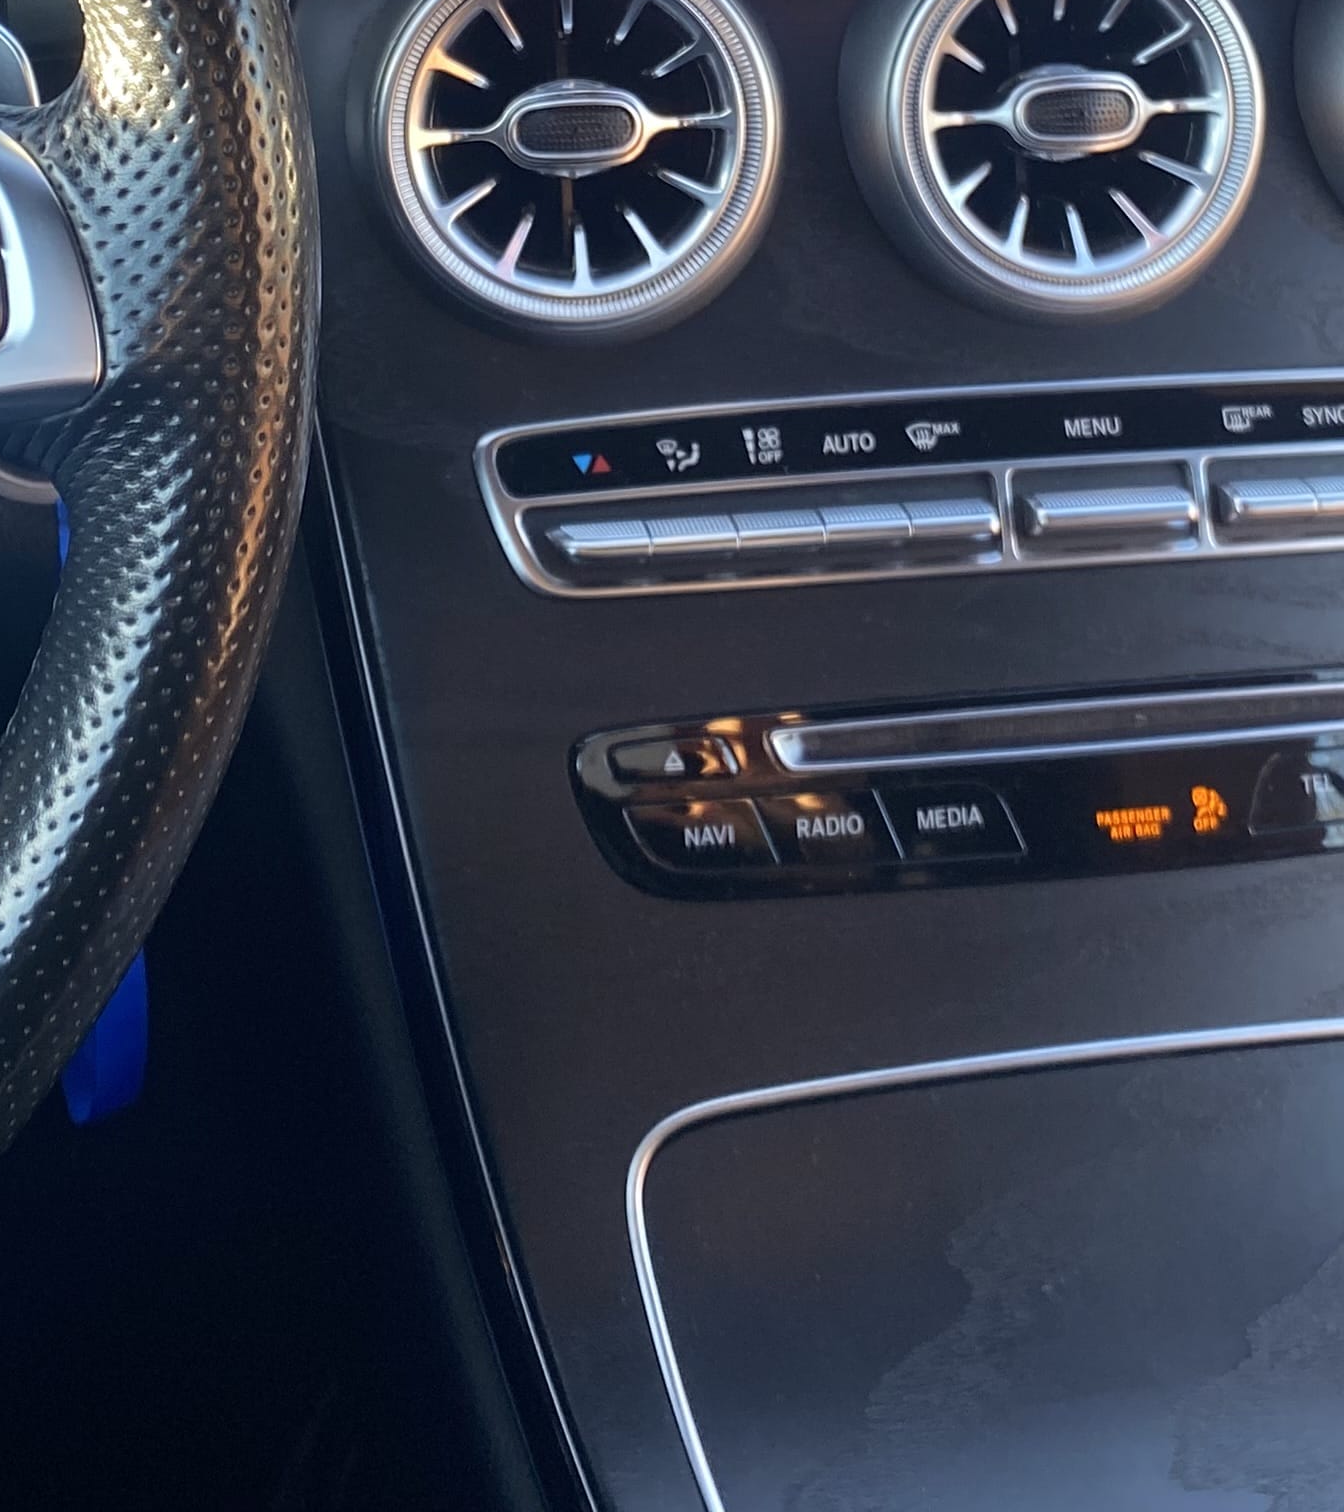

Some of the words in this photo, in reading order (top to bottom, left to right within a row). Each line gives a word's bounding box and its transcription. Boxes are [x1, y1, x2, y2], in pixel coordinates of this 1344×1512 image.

[1242, 405, 1272, 419] REAR
[932, 422, 960, 435] MAX
[1064, 417, 1121, 438] MENU
[823, 432, 875, 455] AUTO
[758, 450, 783, 464] OFF
[917, 806, 985, 830] MEDIA
[1096, 806, 1171, 826] PASSENGER
[1194, 816, 1218, 832] OFF
[684, 824, 735, 849] NAVI
[796, 814, 864, 839] RADIO
[1111, 825, 1131, 840] AIR
[1136, 824, 1160, 838] BAG
